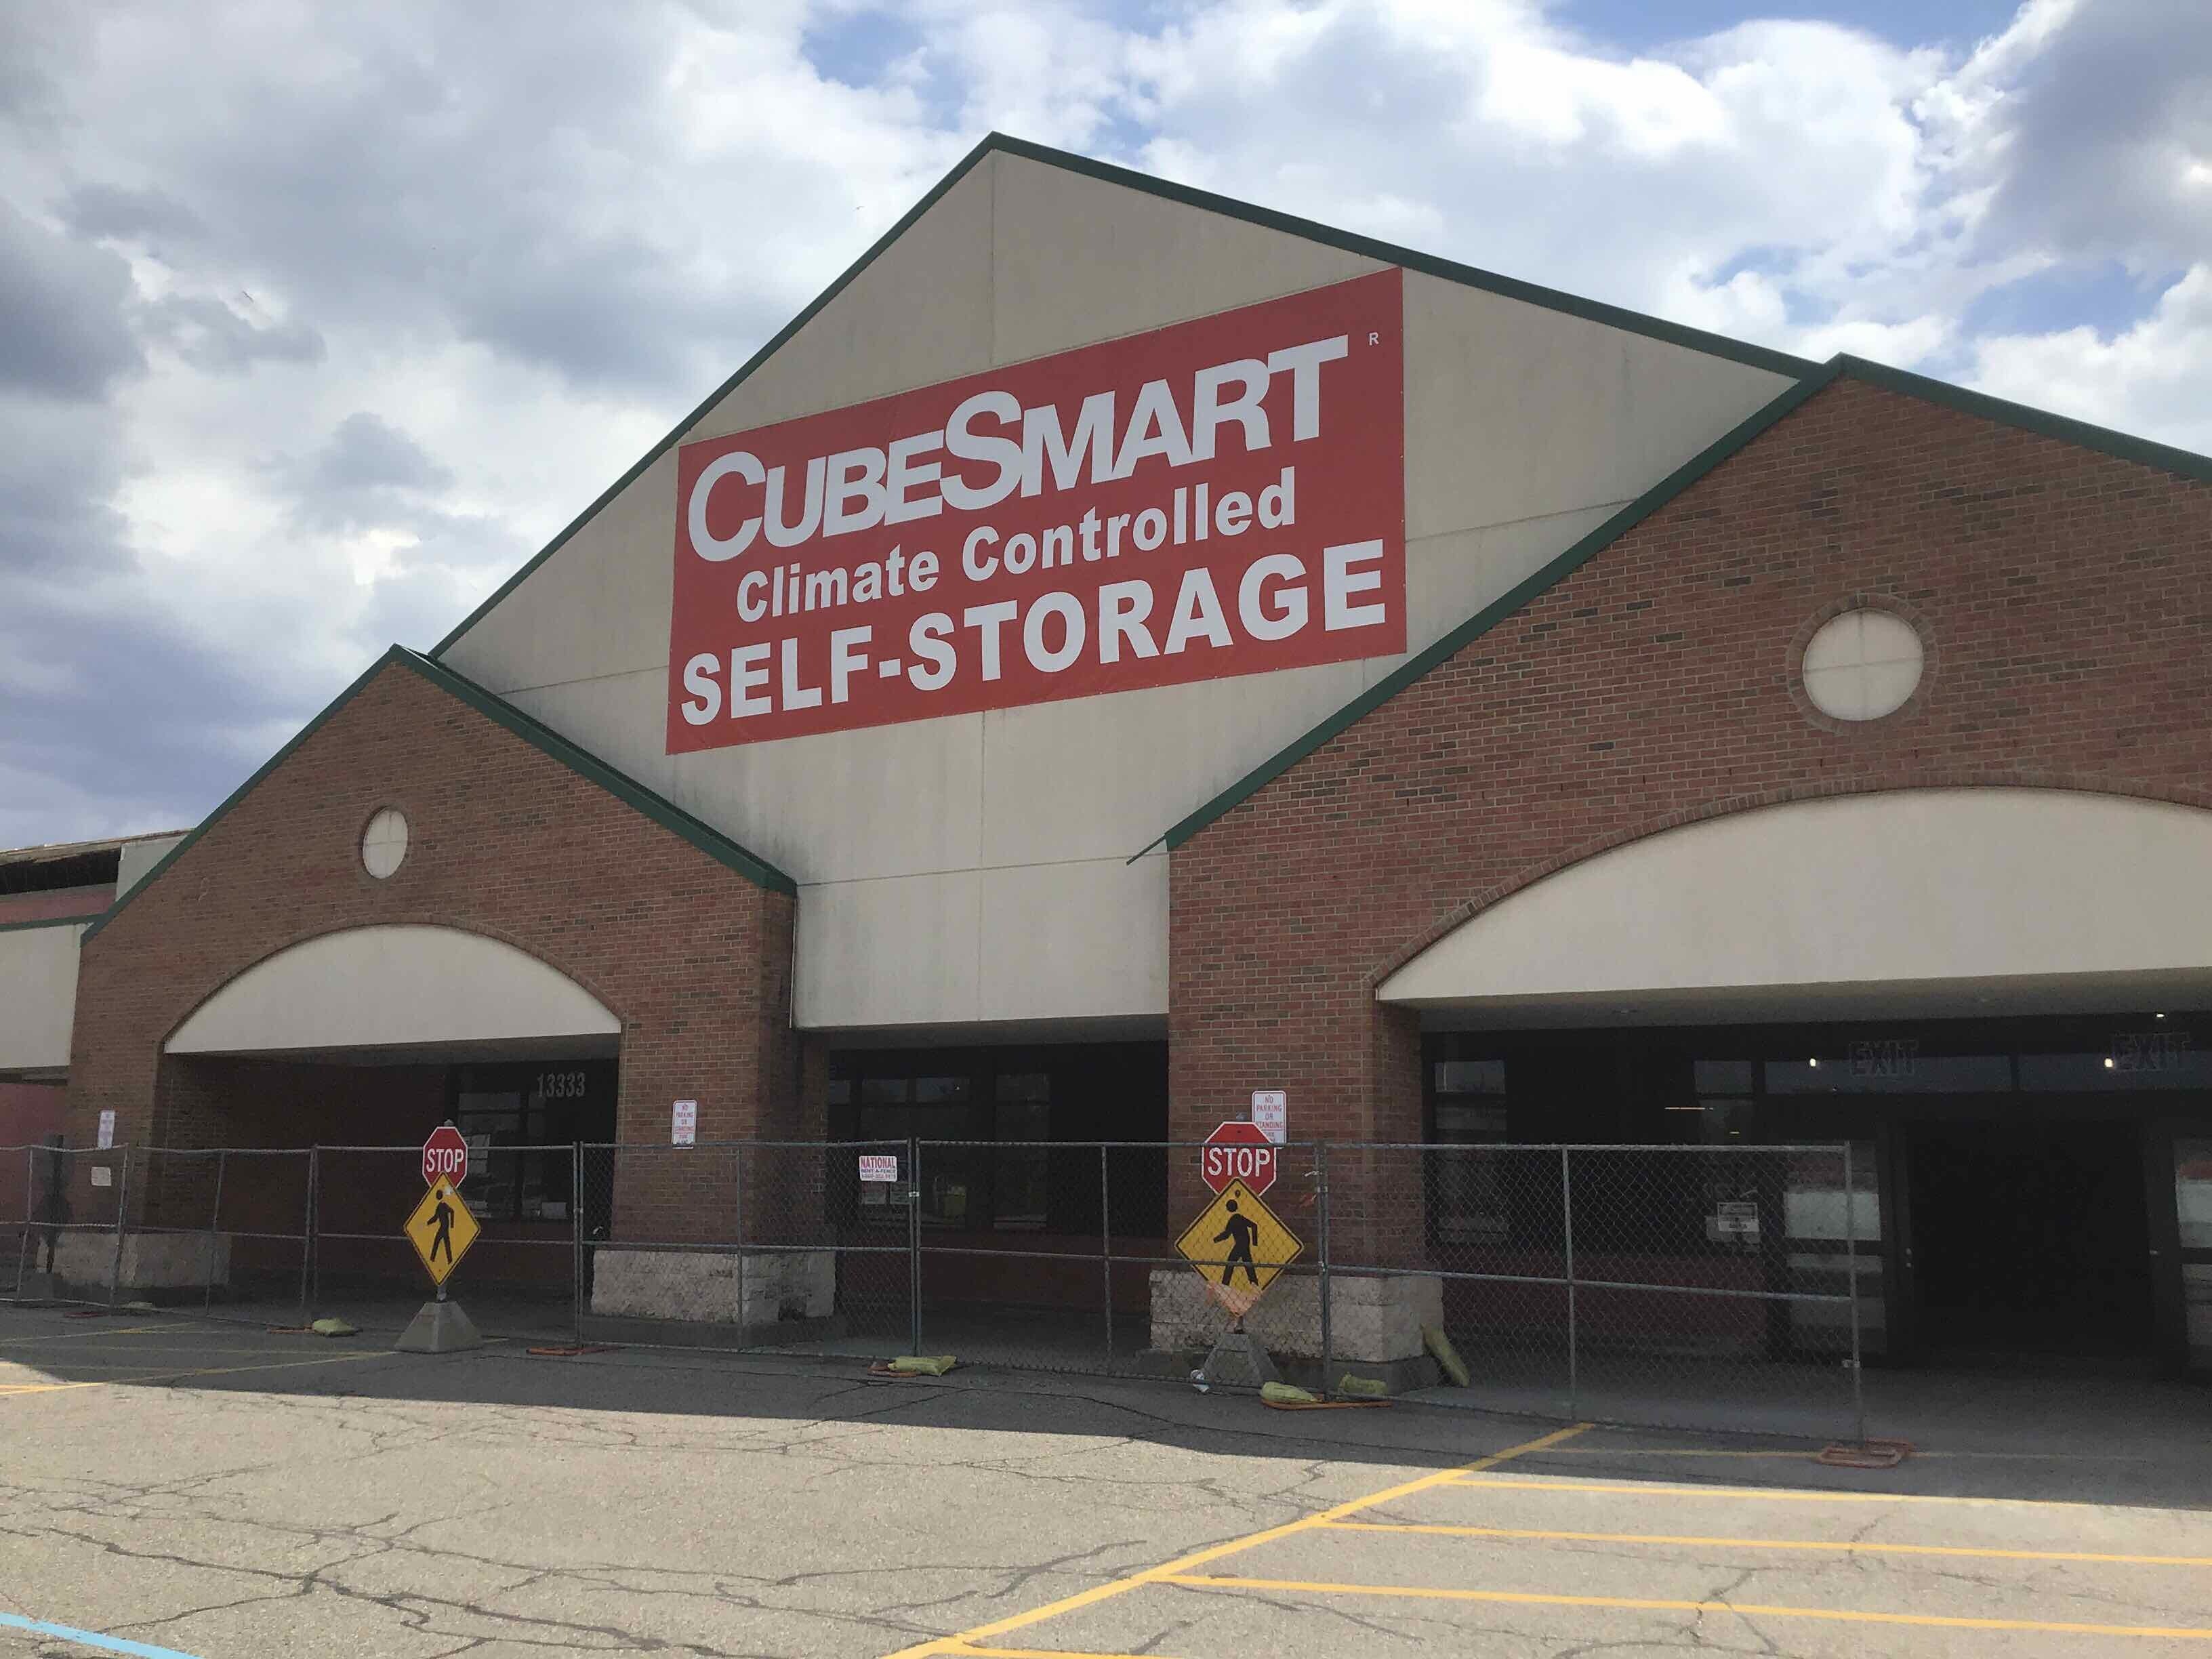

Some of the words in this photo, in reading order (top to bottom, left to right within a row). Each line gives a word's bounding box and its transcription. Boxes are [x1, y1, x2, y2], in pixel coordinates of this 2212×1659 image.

[737, 544, 939, 623] Climate
[962, 466, 1295, 581] Controlled
[681, 538, 1386, 725] SELF-STORAGE
[537, 1072, 586, 1097] 13333
[1256, 1104, 1283, 1112] PARKING
[1265, 1095, 1274, 1104] NO
[1265, 1112, 1273, 1120] OR
[426, 1148, 464, 1172] STOP
[861, 1157, 896, 1168] NATIONAL
[1208, 1147, 1271, 1176] STOP
